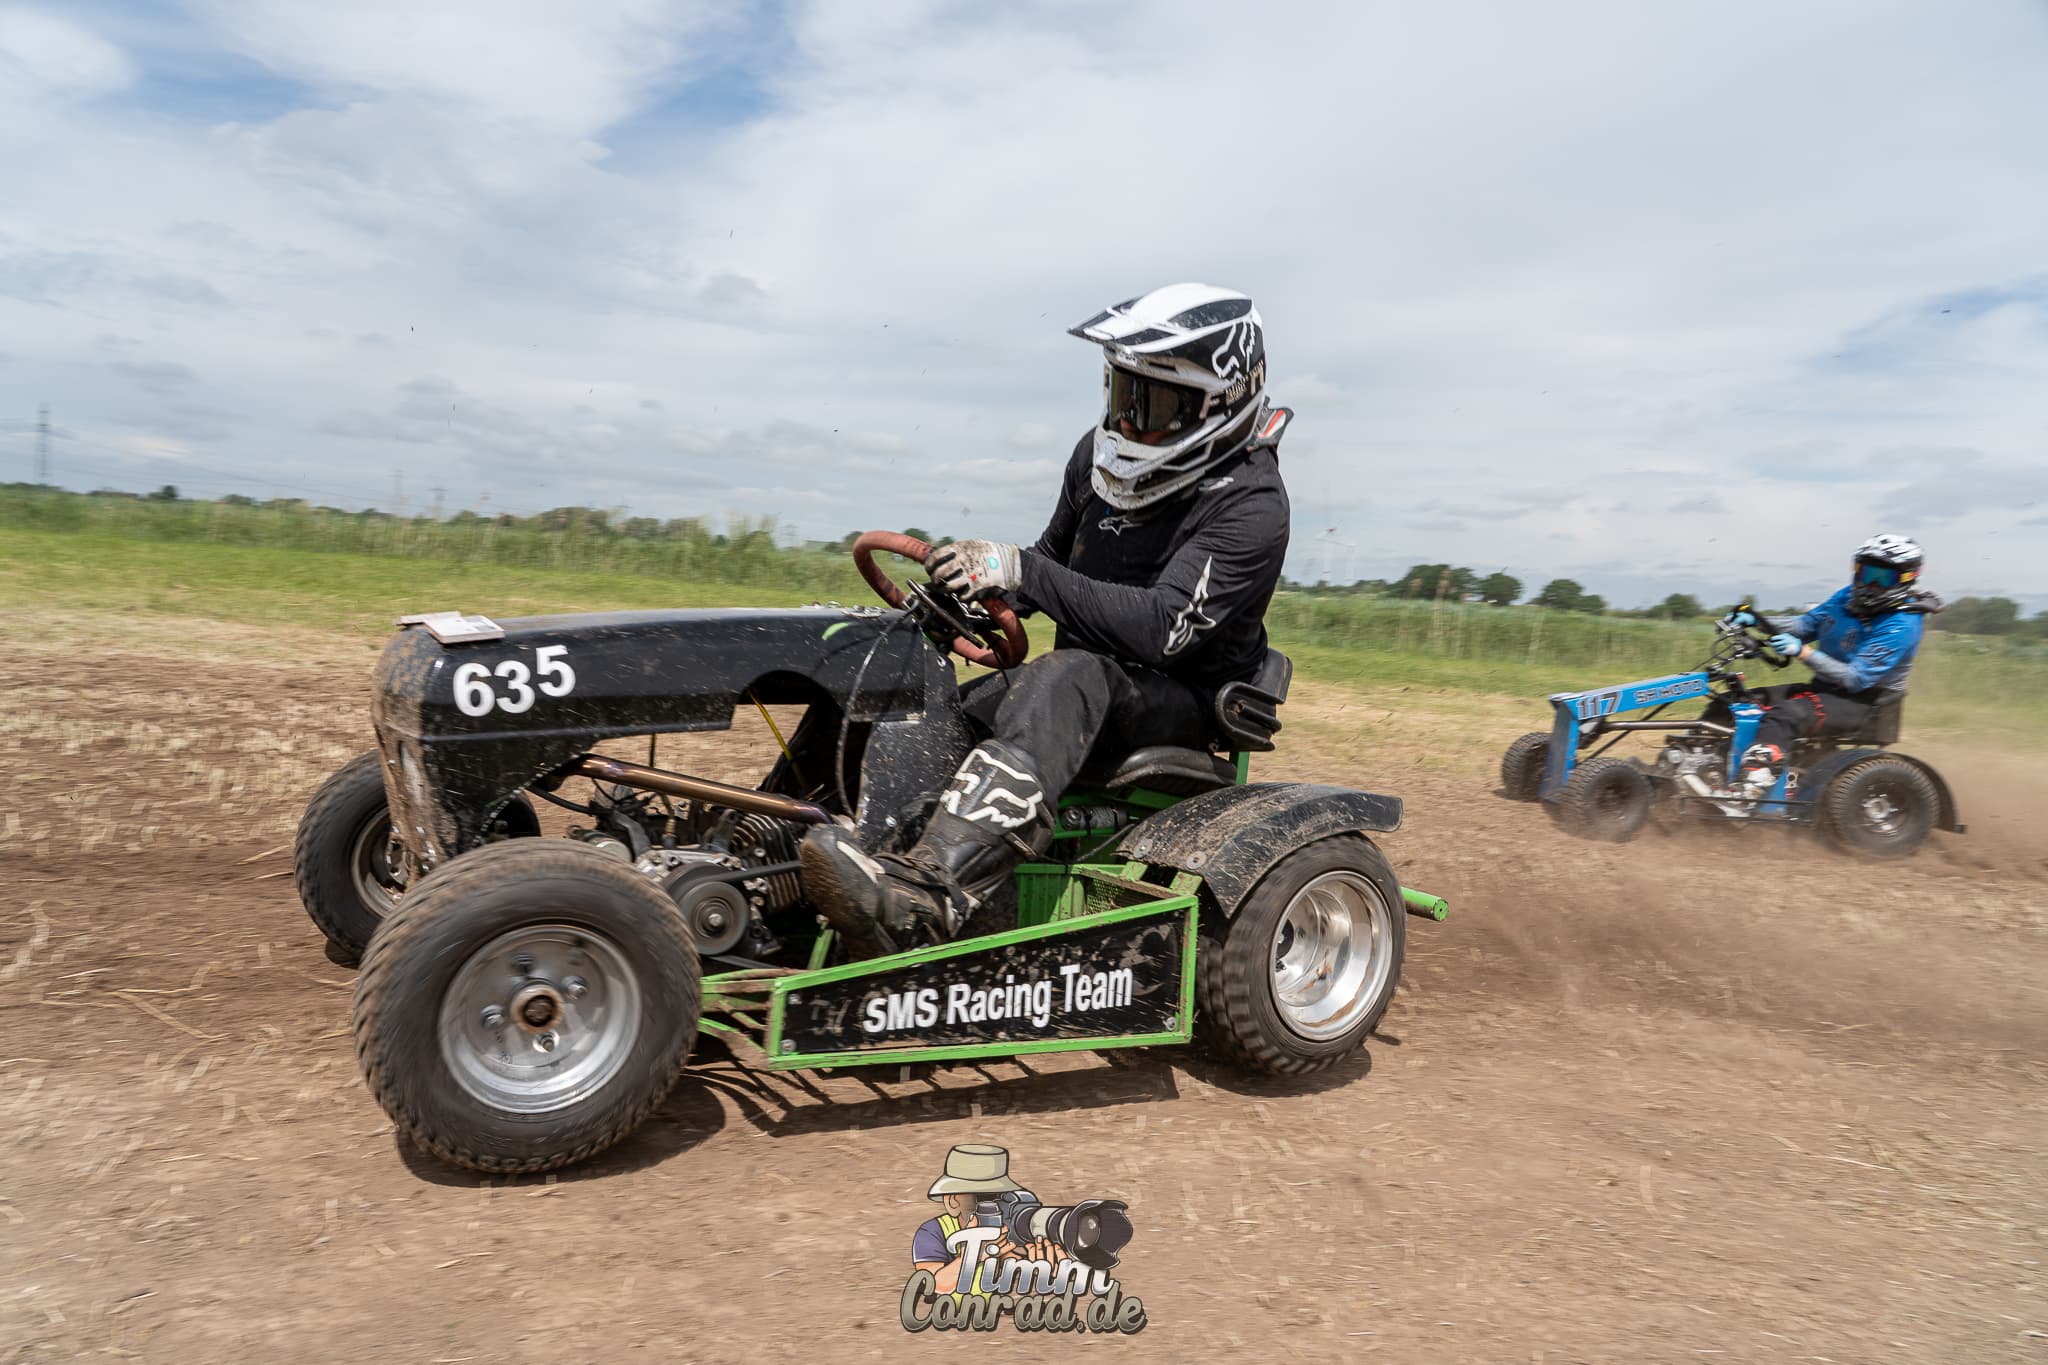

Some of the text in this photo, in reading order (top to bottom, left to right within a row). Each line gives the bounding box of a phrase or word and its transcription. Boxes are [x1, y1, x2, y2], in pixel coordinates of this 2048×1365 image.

[453, 644, 577, 717] 635
[1576, 690, 1623, 721] 117
[863, 964, 1133, 1033] SMS Racing Team
